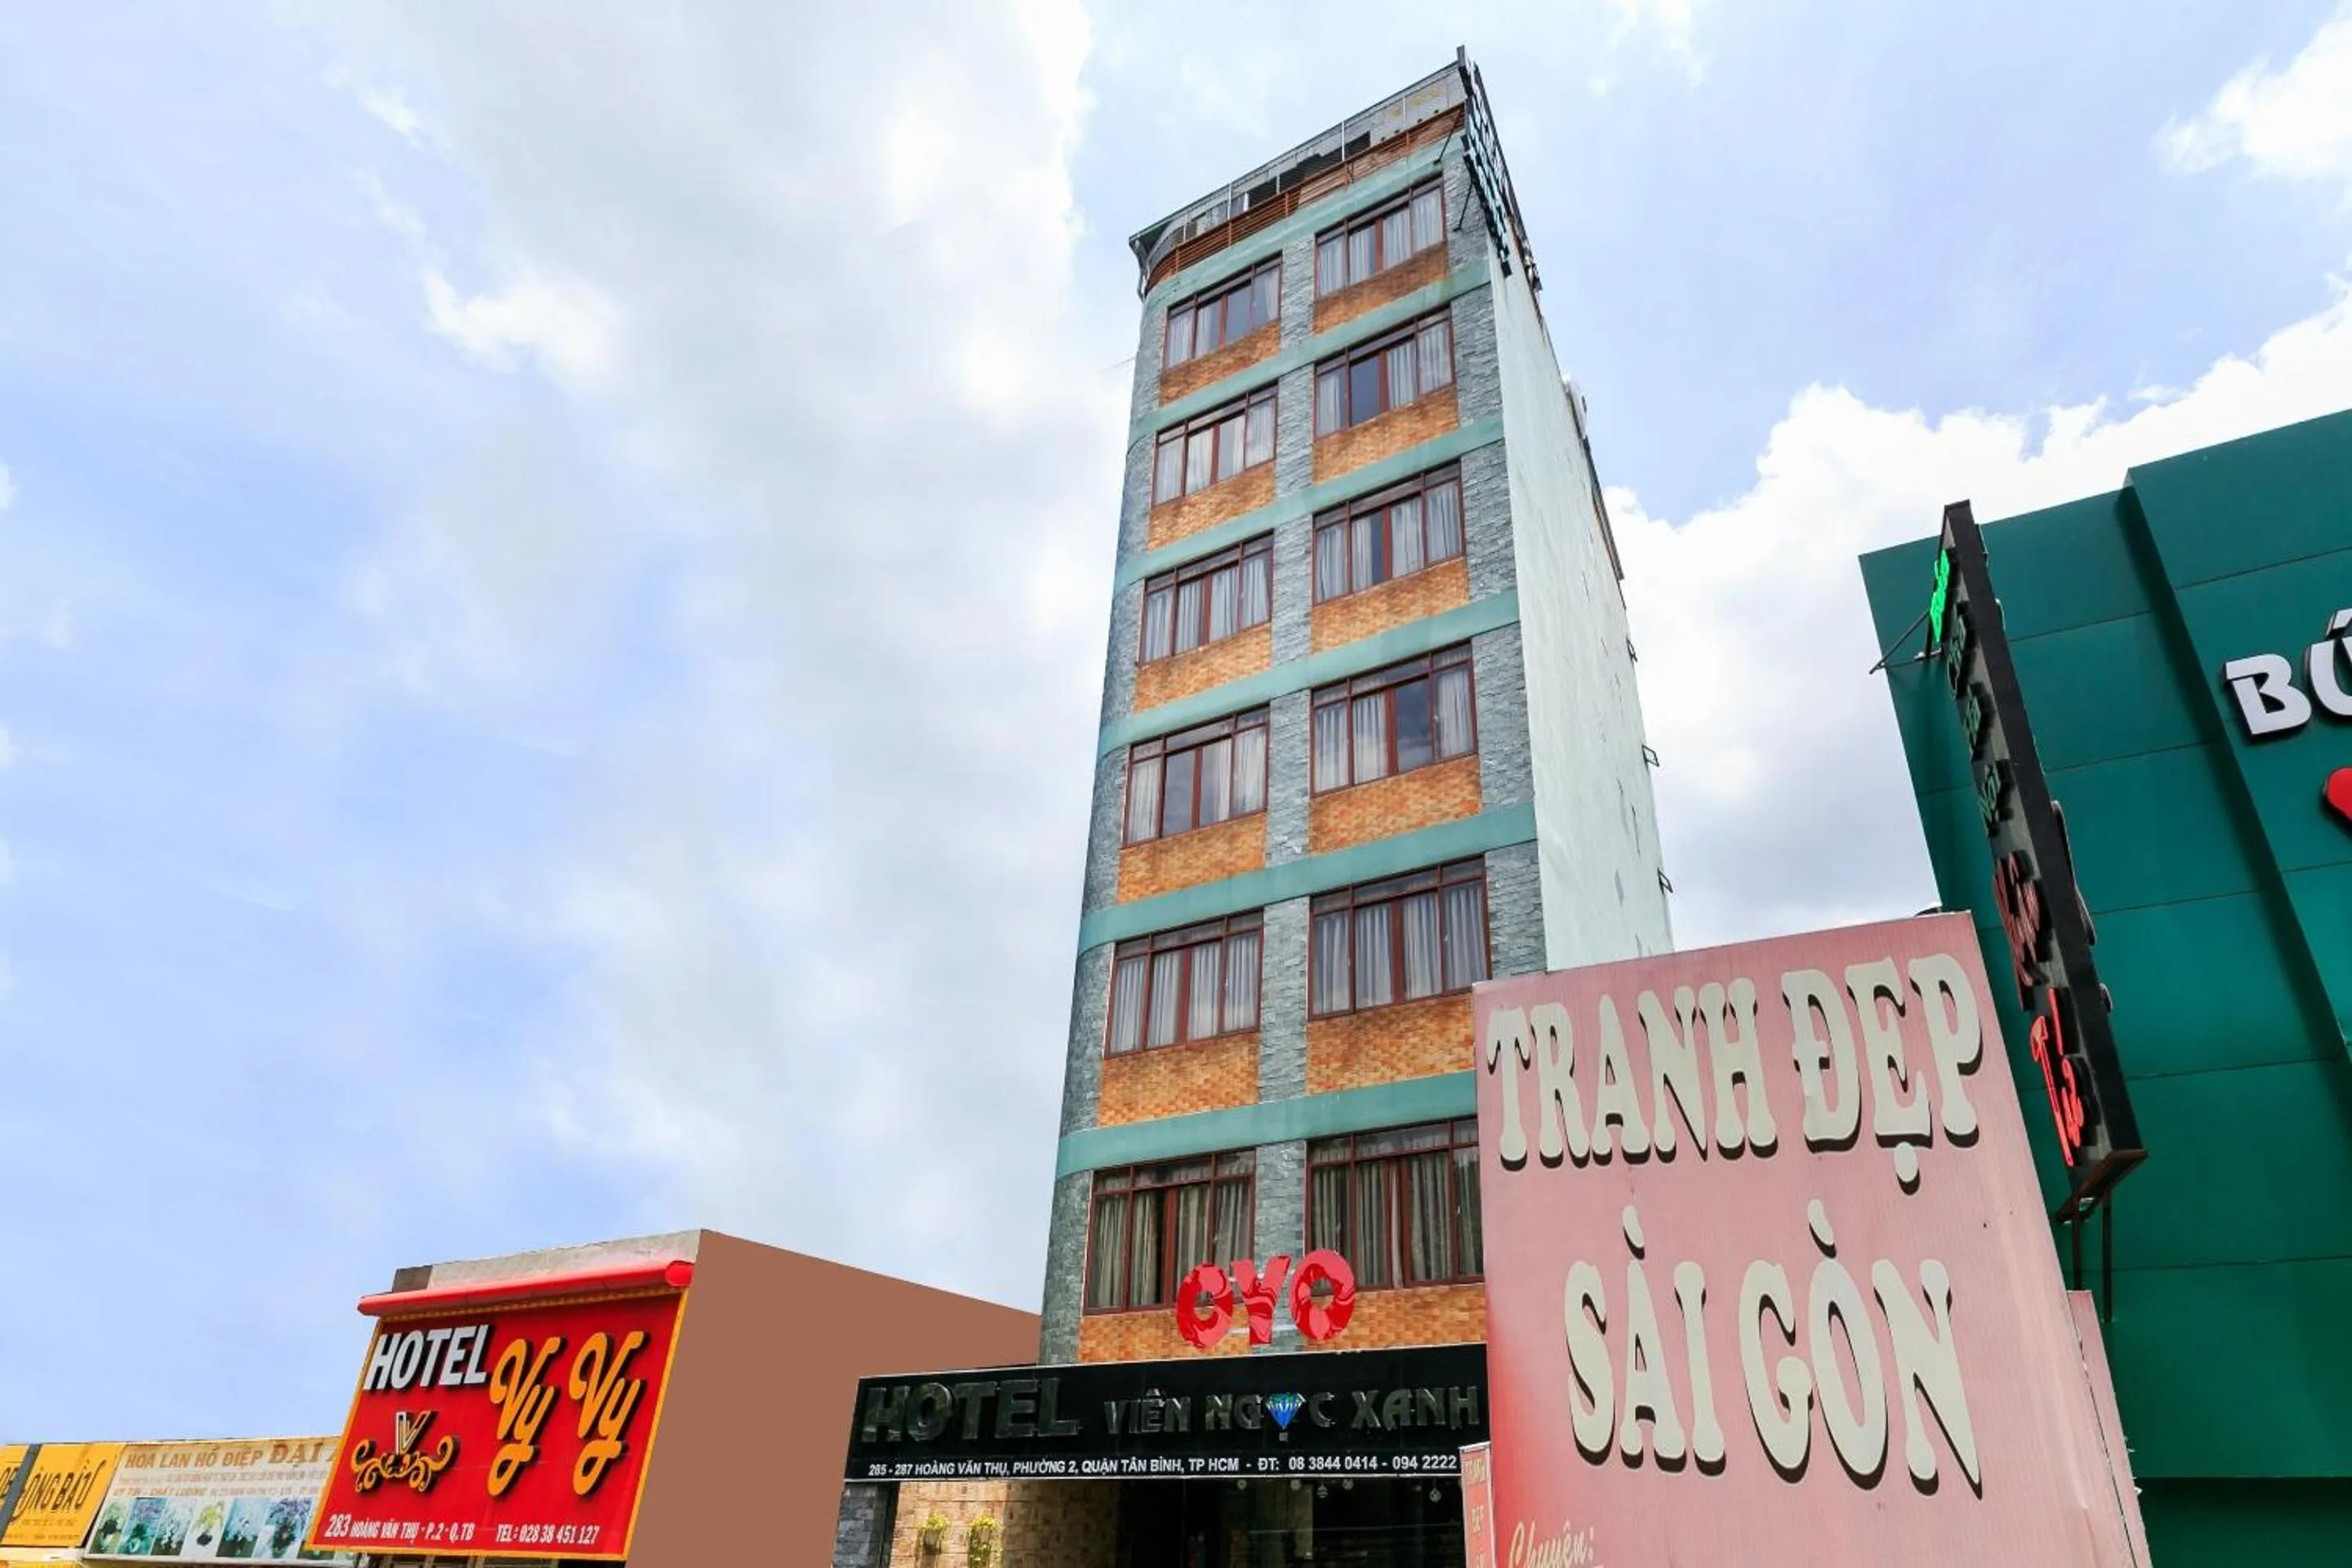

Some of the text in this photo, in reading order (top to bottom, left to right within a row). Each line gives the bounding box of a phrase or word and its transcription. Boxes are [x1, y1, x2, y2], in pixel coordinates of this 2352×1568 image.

[1486, 953, 1984, 1195] TRANH ĐẸP
[1176, 1248, 1356, 1349] OYO
[363, 1324, 490, 1390] HOTEL
[1565, 1199, 1984, 1500] SÀI GÒN
[861, 1377, 1080, 1444] HOTEL
[1350, 1385, 1480, 1431] XANH
[125, 1453, 156, 1468] HOA
[159, 1452, 192, 1468] LAN
[894, 1463, 913, 1475] 287
[915, 1459, 956, 1475] HOÀNG
[957, 1459, 982, 1475] VĂN
[1067, 1460, 1079, 1474] 2,
[1120, 1456, 1147, 1472] TÂN
[1188, 1458, 1205, 1471] TP
[1208, 1458, 1240, 1471] HCM
[1258, 1457, 1280, 1471] ĐT:
[1288, 1456, 1305, 1471] 08
[1308, 1455, 1341, 1470] 3844
[1344, 1455, 1378, 1470] 0414
[1392, 1455, 1419, 1469] 094
[1421, 1454, 1457, 1469] 2222
[324, 1513, 352, 1538] 283
[519, 1524, 540, 1543] 028
[540, 1524, 556, 1544] 38
[556, 1525, 577, 1544] 451
[577, 1525, 600, 1545] 127
